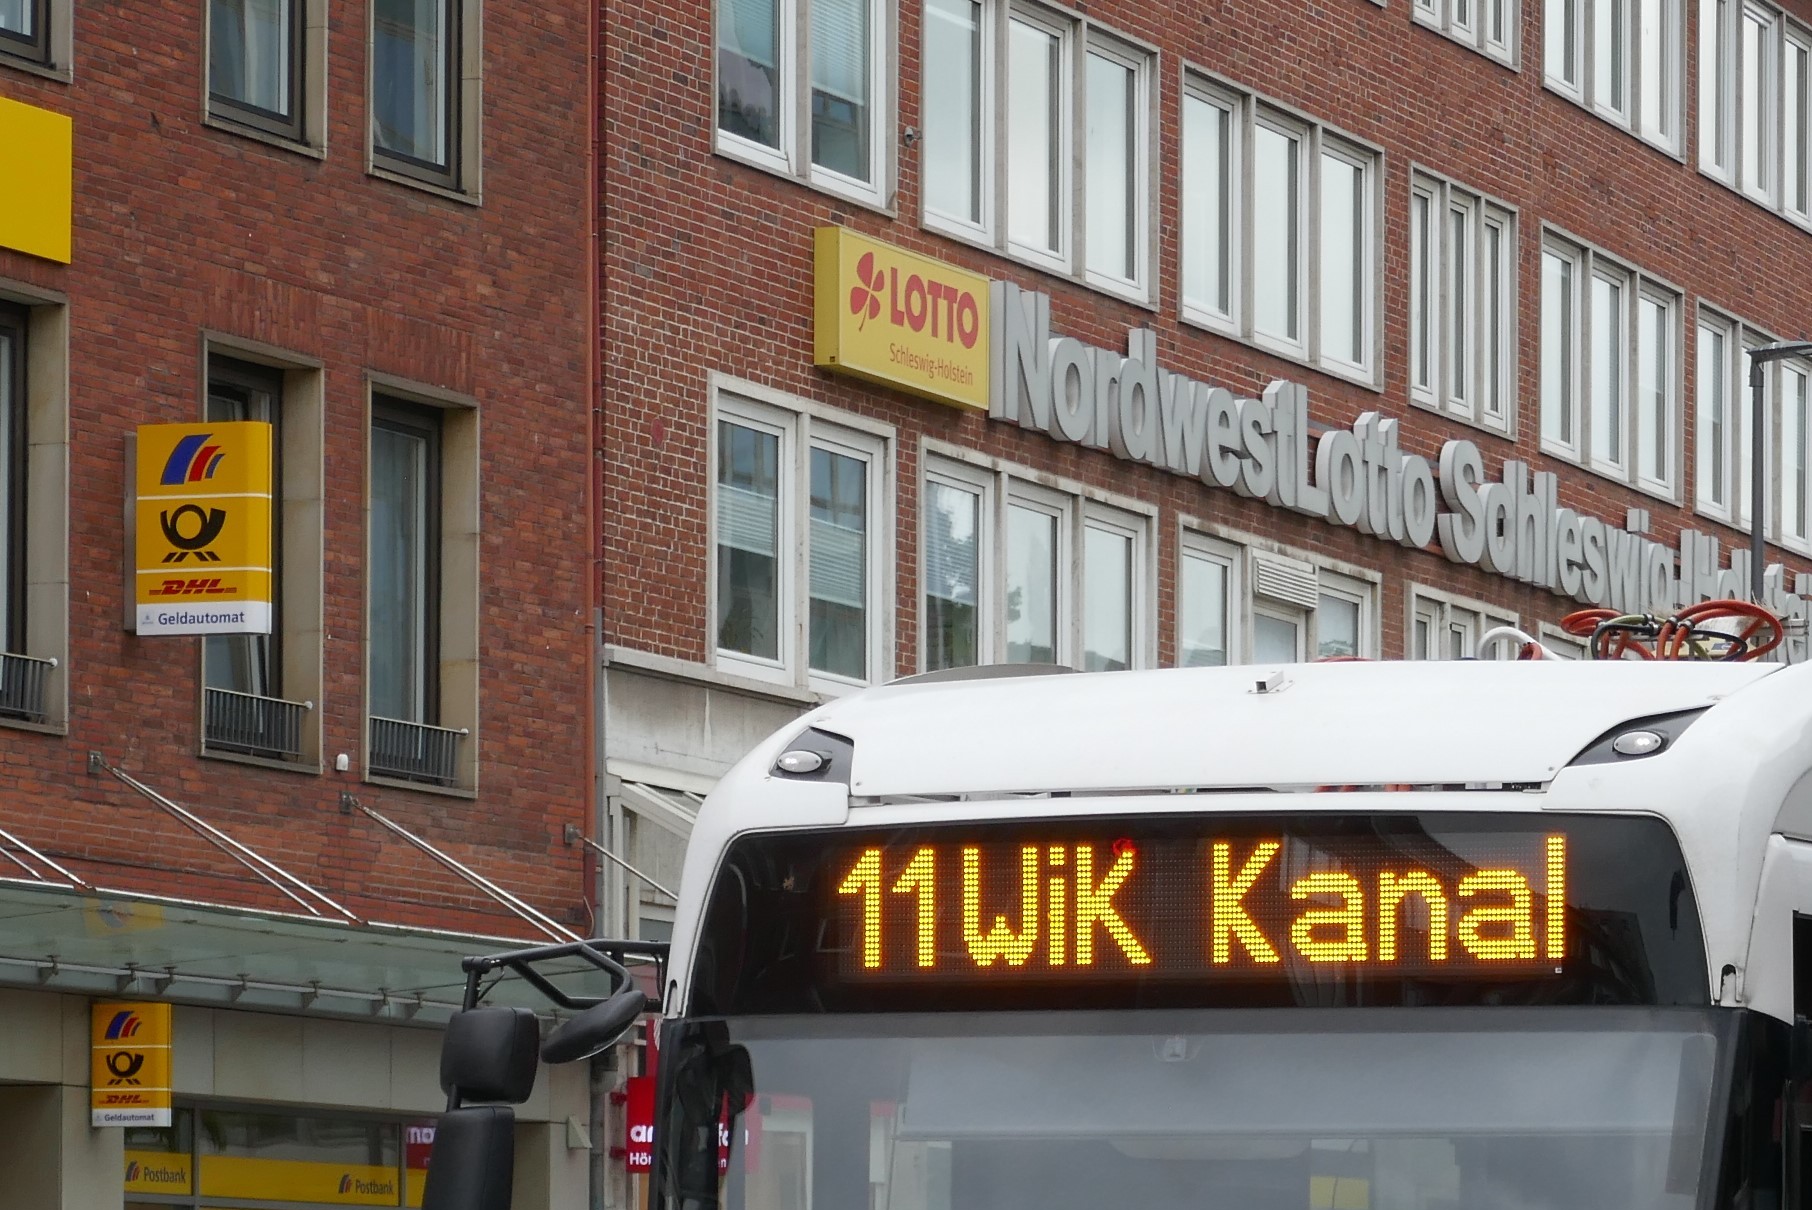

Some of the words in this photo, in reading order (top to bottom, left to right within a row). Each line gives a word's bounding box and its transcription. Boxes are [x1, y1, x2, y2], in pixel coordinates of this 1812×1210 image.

[890, 267, 979, 350] LOTTO
[889, 343, 974, 386] Schleswig-Holstein
[158, 578, 226, 596] DHL
[158, 612, 245, 626] Geldautomat
[837, 846, 937, 970] 11
[1210, 834, 1567, 965] Kanal
[107, 1094, 142, 1104] DHL
[104, 1114, 155, 1122] Geldautomat
[143, 1166, 186, 1184] Postbank
[355, 1179, 394, 1195] Postbank
